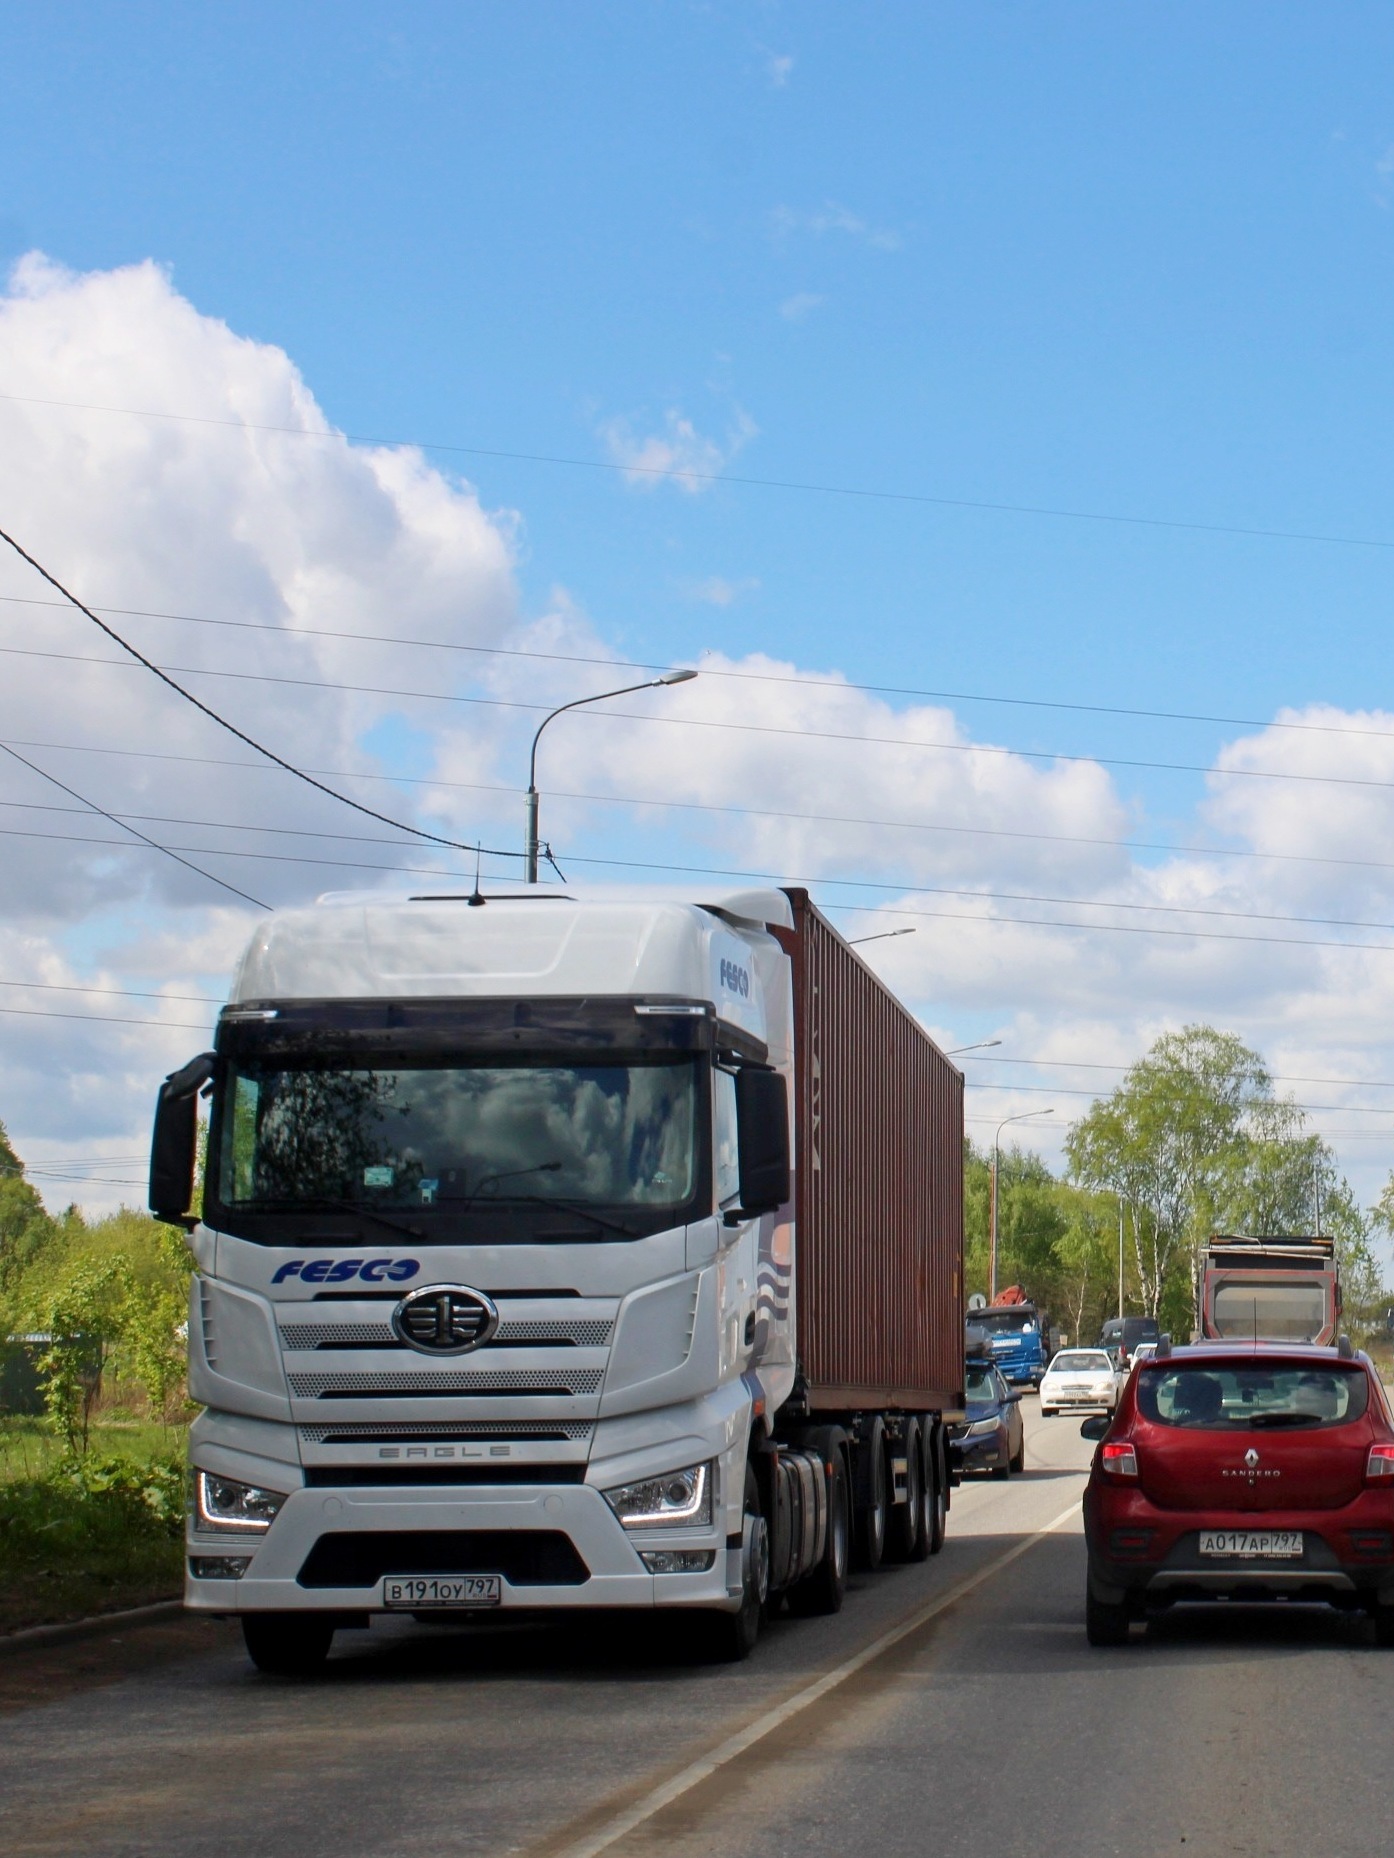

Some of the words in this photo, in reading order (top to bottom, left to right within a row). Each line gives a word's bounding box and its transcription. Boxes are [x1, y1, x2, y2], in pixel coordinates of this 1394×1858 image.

[720, 957, 749, 999] FESCO
[271, 1258, 420, 1284] FESCO
[379, 1446, 511, 1458] EAGLE
